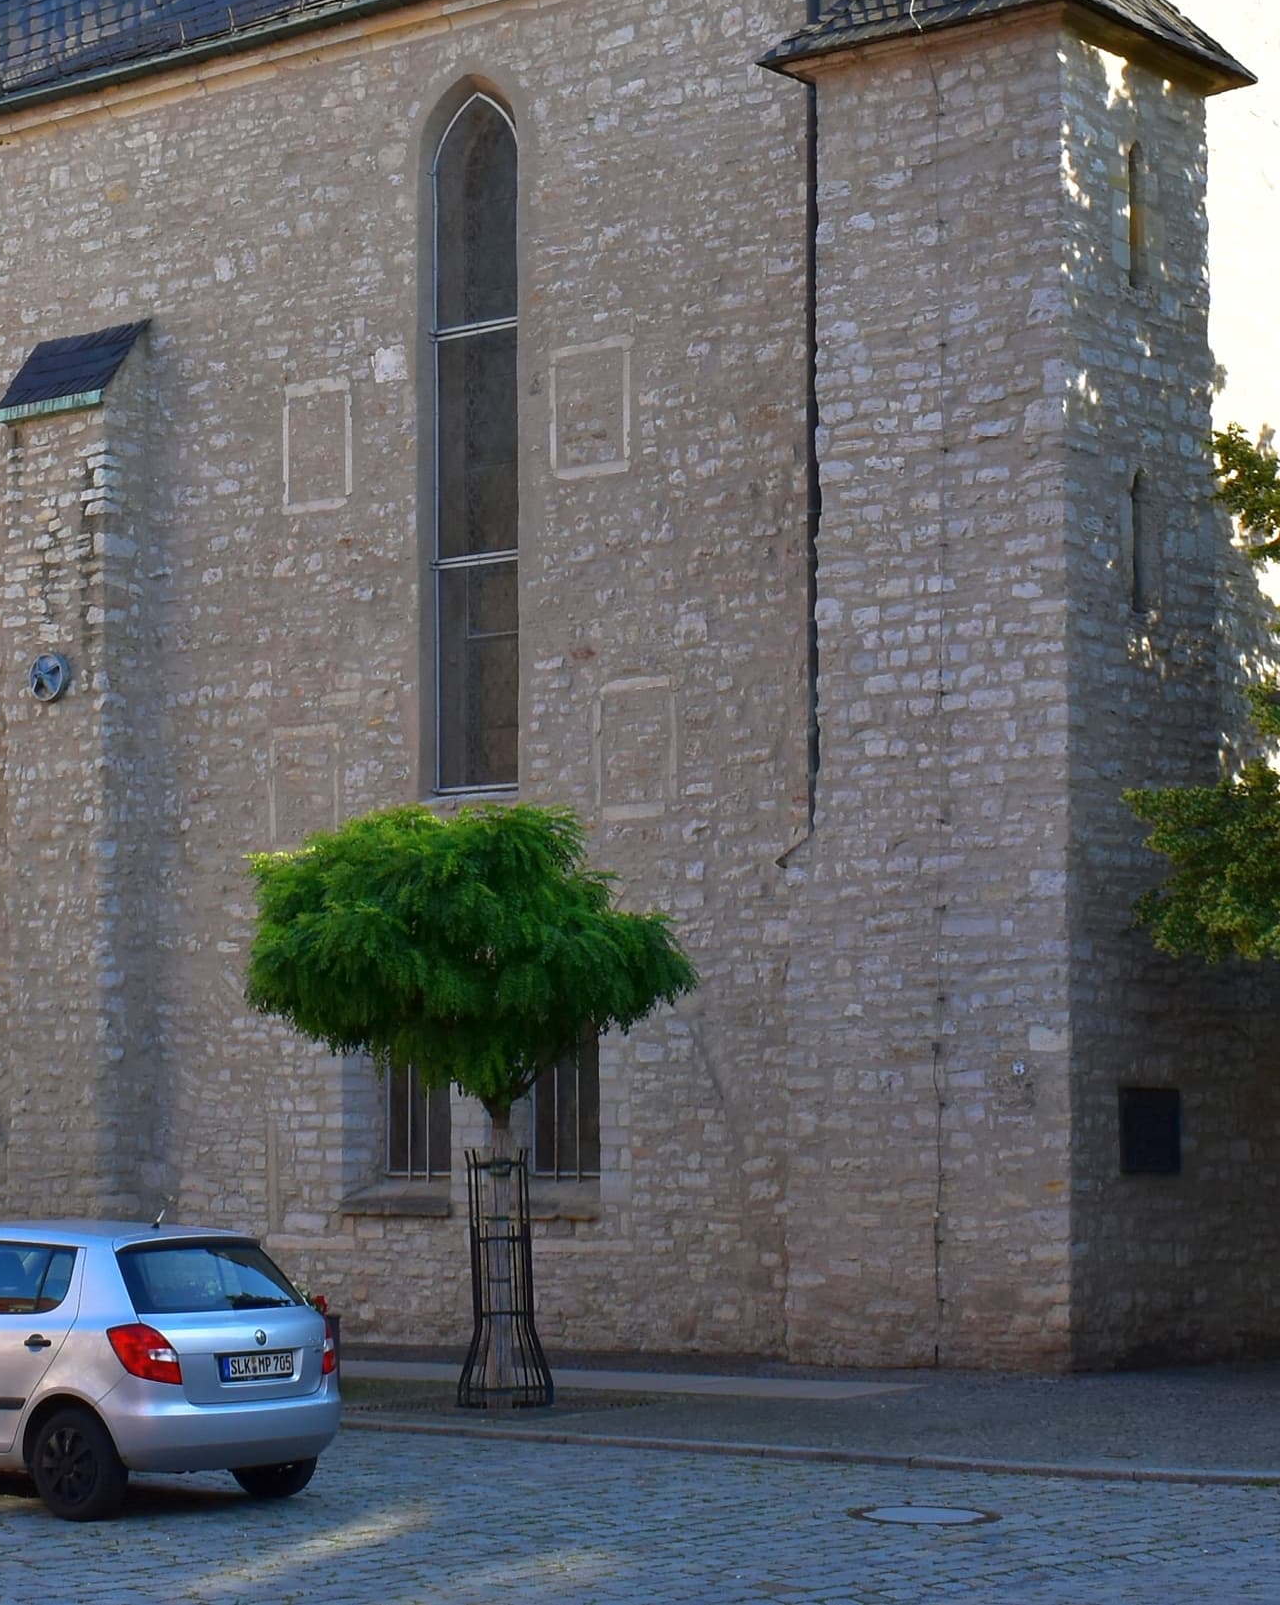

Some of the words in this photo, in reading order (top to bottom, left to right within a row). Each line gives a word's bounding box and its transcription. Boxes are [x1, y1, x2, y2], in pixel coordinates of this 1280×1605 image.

[231, 1357, 251, 1375] SLK
[258, 1356, 271, 1372] MP
[273, 1355, 291, 1371] 705
